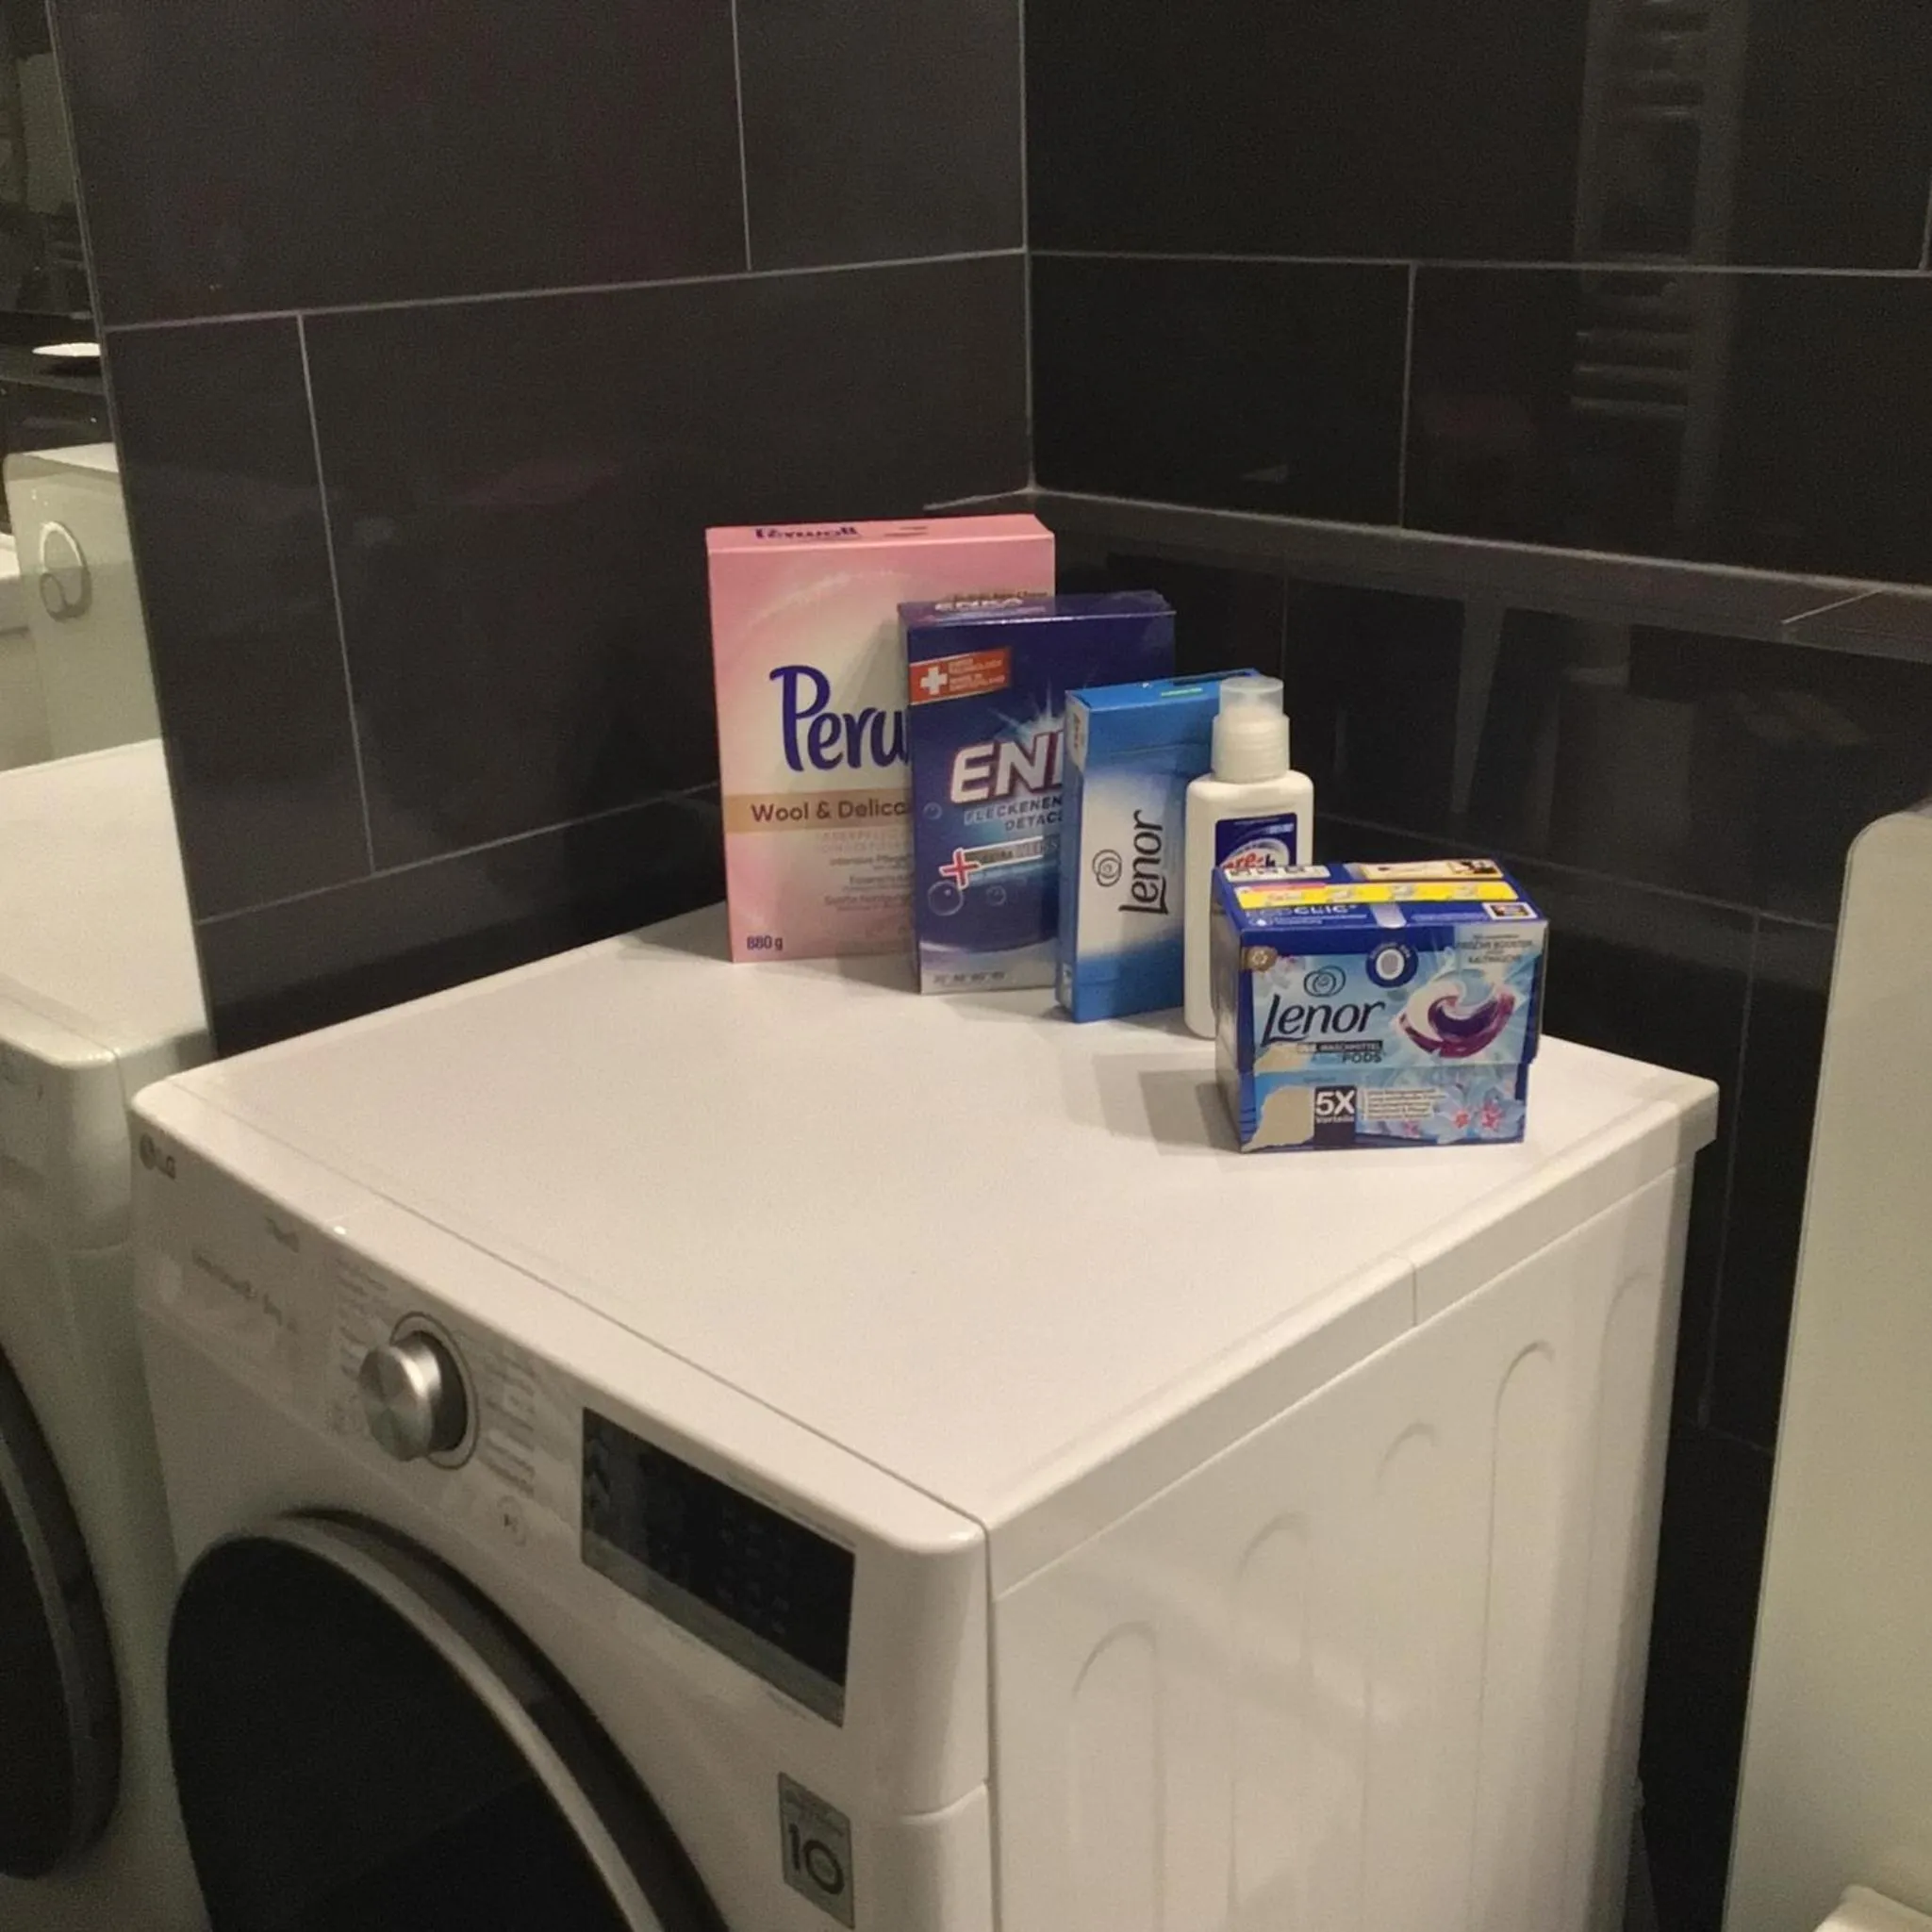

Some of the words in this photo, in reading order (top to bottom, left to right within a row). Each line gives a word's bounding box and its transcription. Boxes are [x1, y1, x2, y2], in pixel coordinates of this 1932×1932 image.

[751, 802, 809, 822] Wool
[817, 800, 832, 819] &
[1118, 810, 1169, 915] Lenor
[774, 937, 784, 951] g
[1261, 993, 1386, 1048] Lenor
[1342, 1052, 1382, 1064] PODS
[1316, 1090, 1355, 1115] 5X
